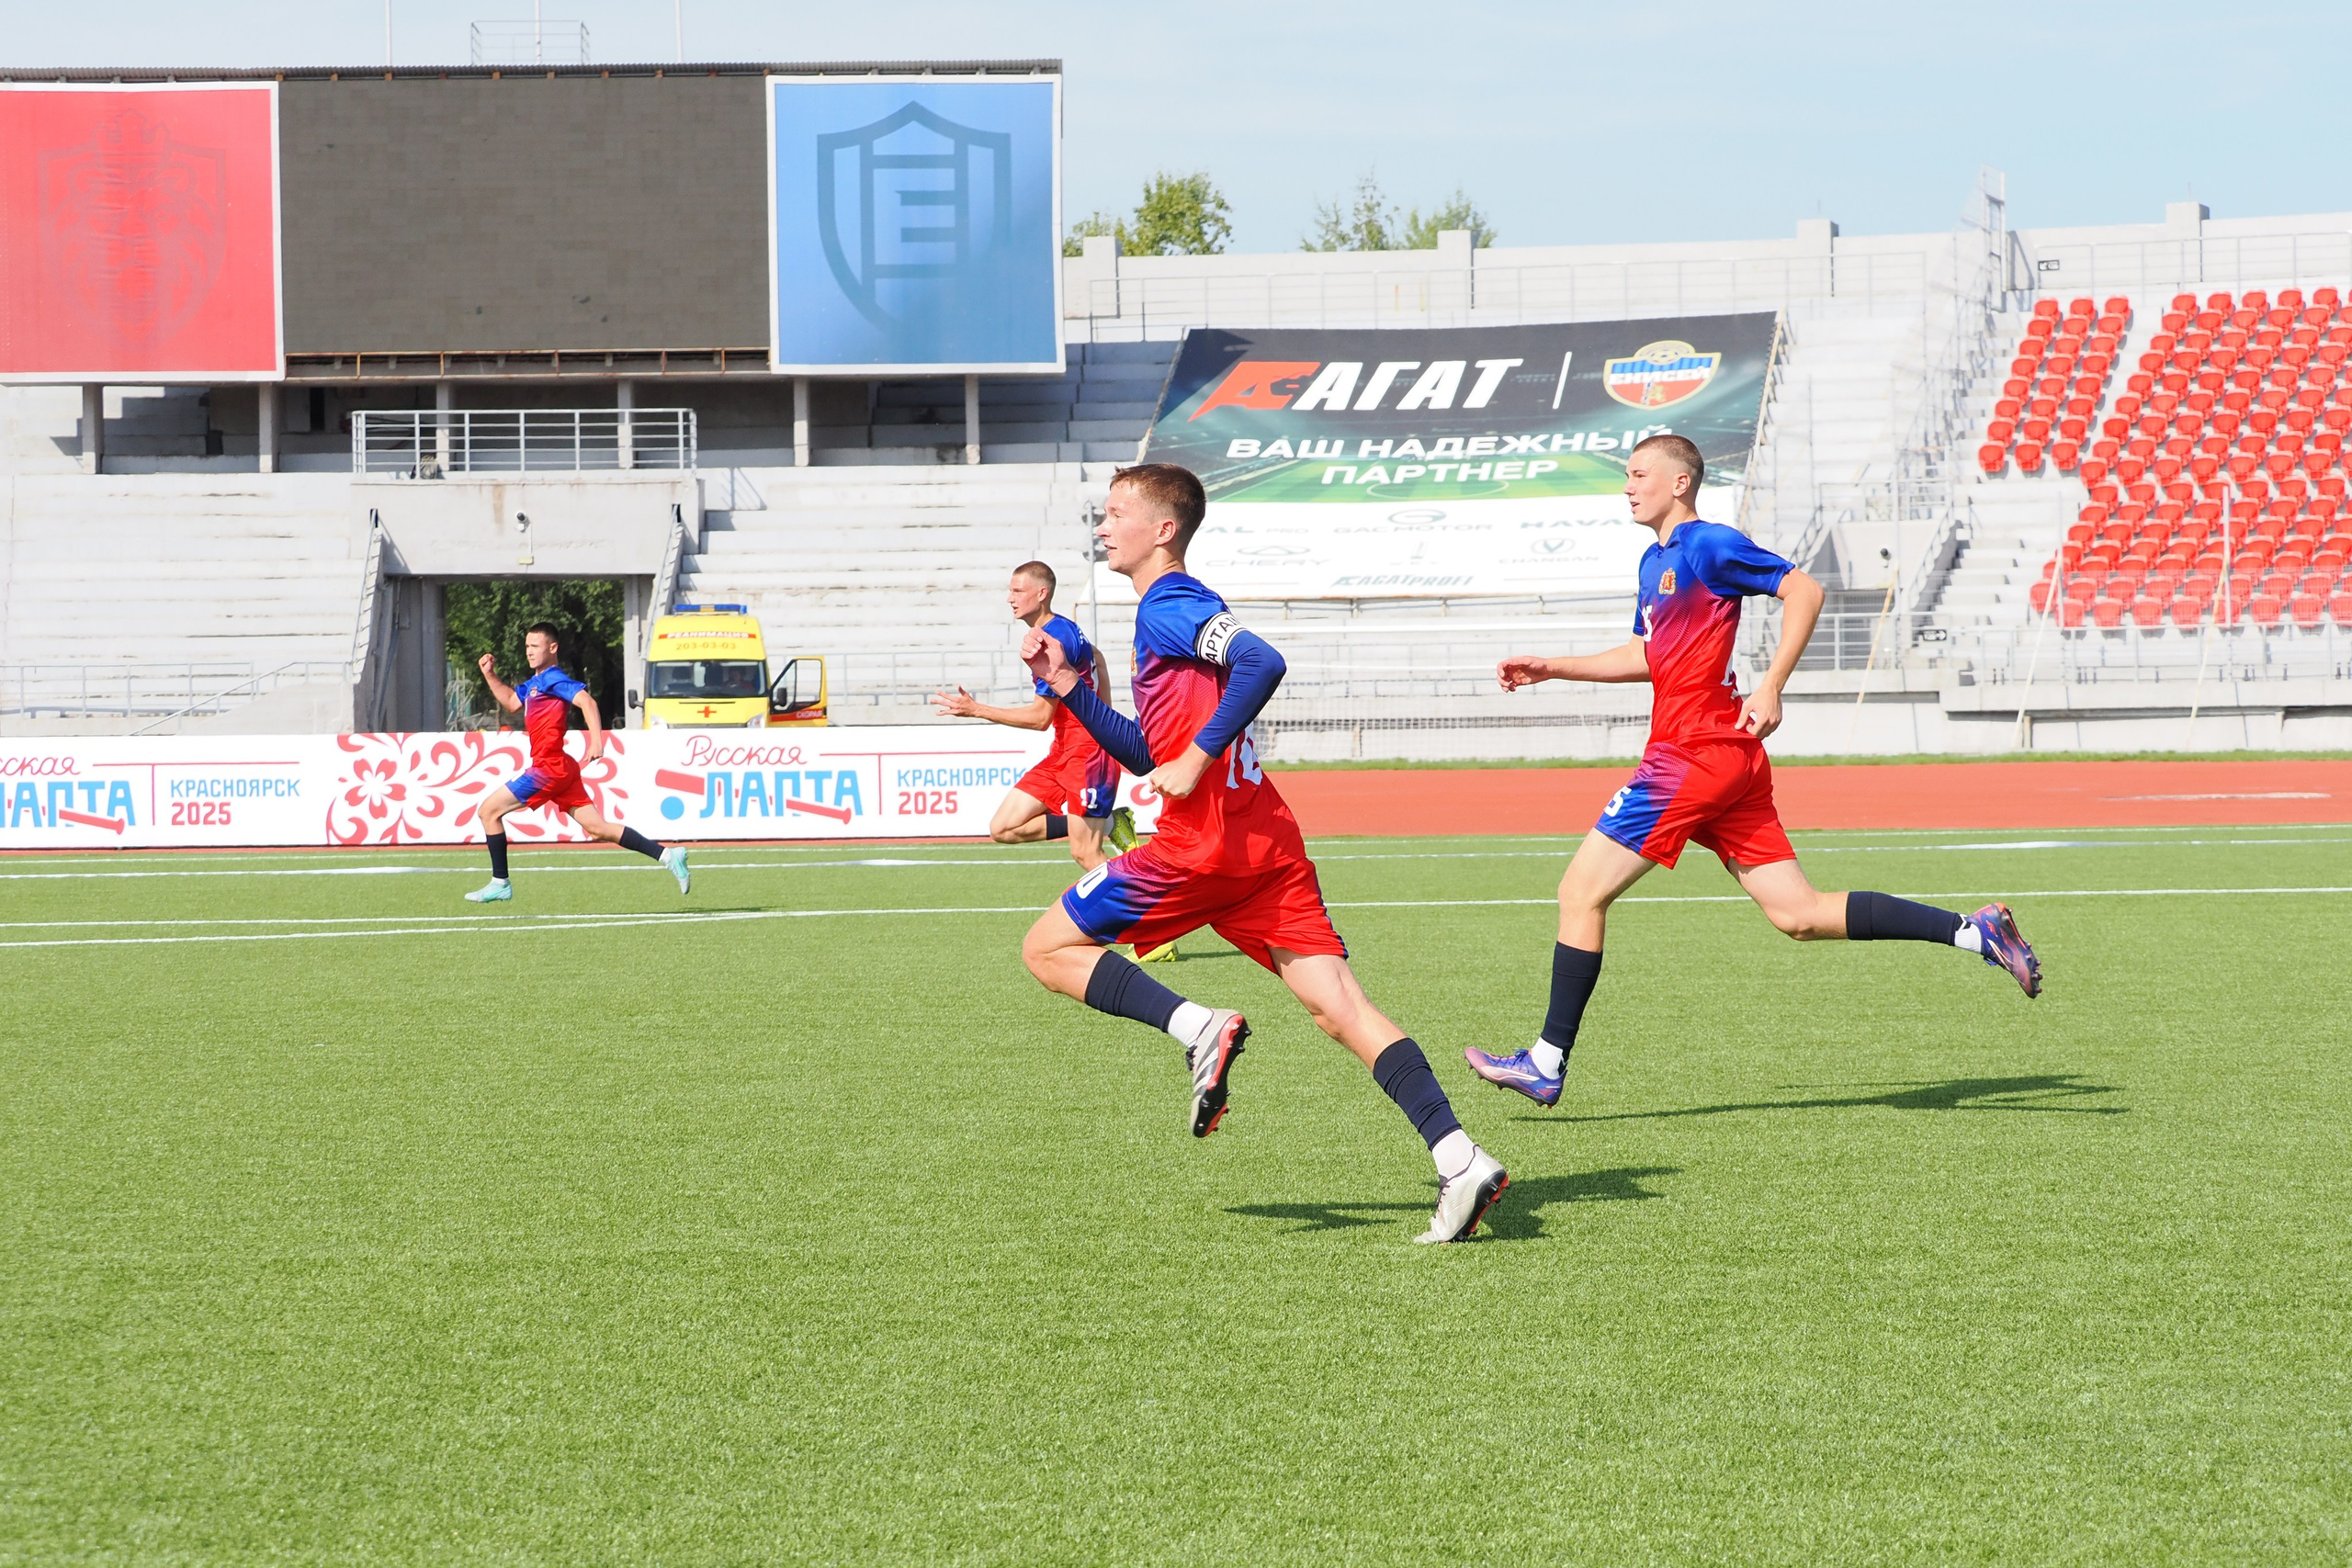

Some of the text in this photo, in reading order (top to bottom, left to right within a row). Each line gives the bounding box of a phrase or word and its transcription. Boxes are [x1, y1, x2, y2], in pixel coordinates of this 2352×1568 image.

[1291, 358, 1523, 411] АГАТ
[1227, 439, 1344, 458] ВАШ
[1321, 459, 1558, 484] ПАРТНЕР
[1394, 523, 1494, 532] MOTOR
[1521, 517, 1634, 529] HAVA
[1205, 558, 1331, 567] CHERY
[1499, 555, 1600, 564] CHANGAN
[667, 631, 750, 639] РЕАНИМАЦИЯ
[1204, 616, 1240, 663] APTAI
[676, 641, 738, 650] 203-03-03
[681, 735, 808, 766] Русская
[898, 768, 1026, 787] КРАСНОЯРСК
[171, 779, 300, 797] КРАСНОЯРСК
[700, 770, 864, 818] ЛАПТА
[899, 791, 958, 815] 2025
[171, 802, 232, 825] 2025
